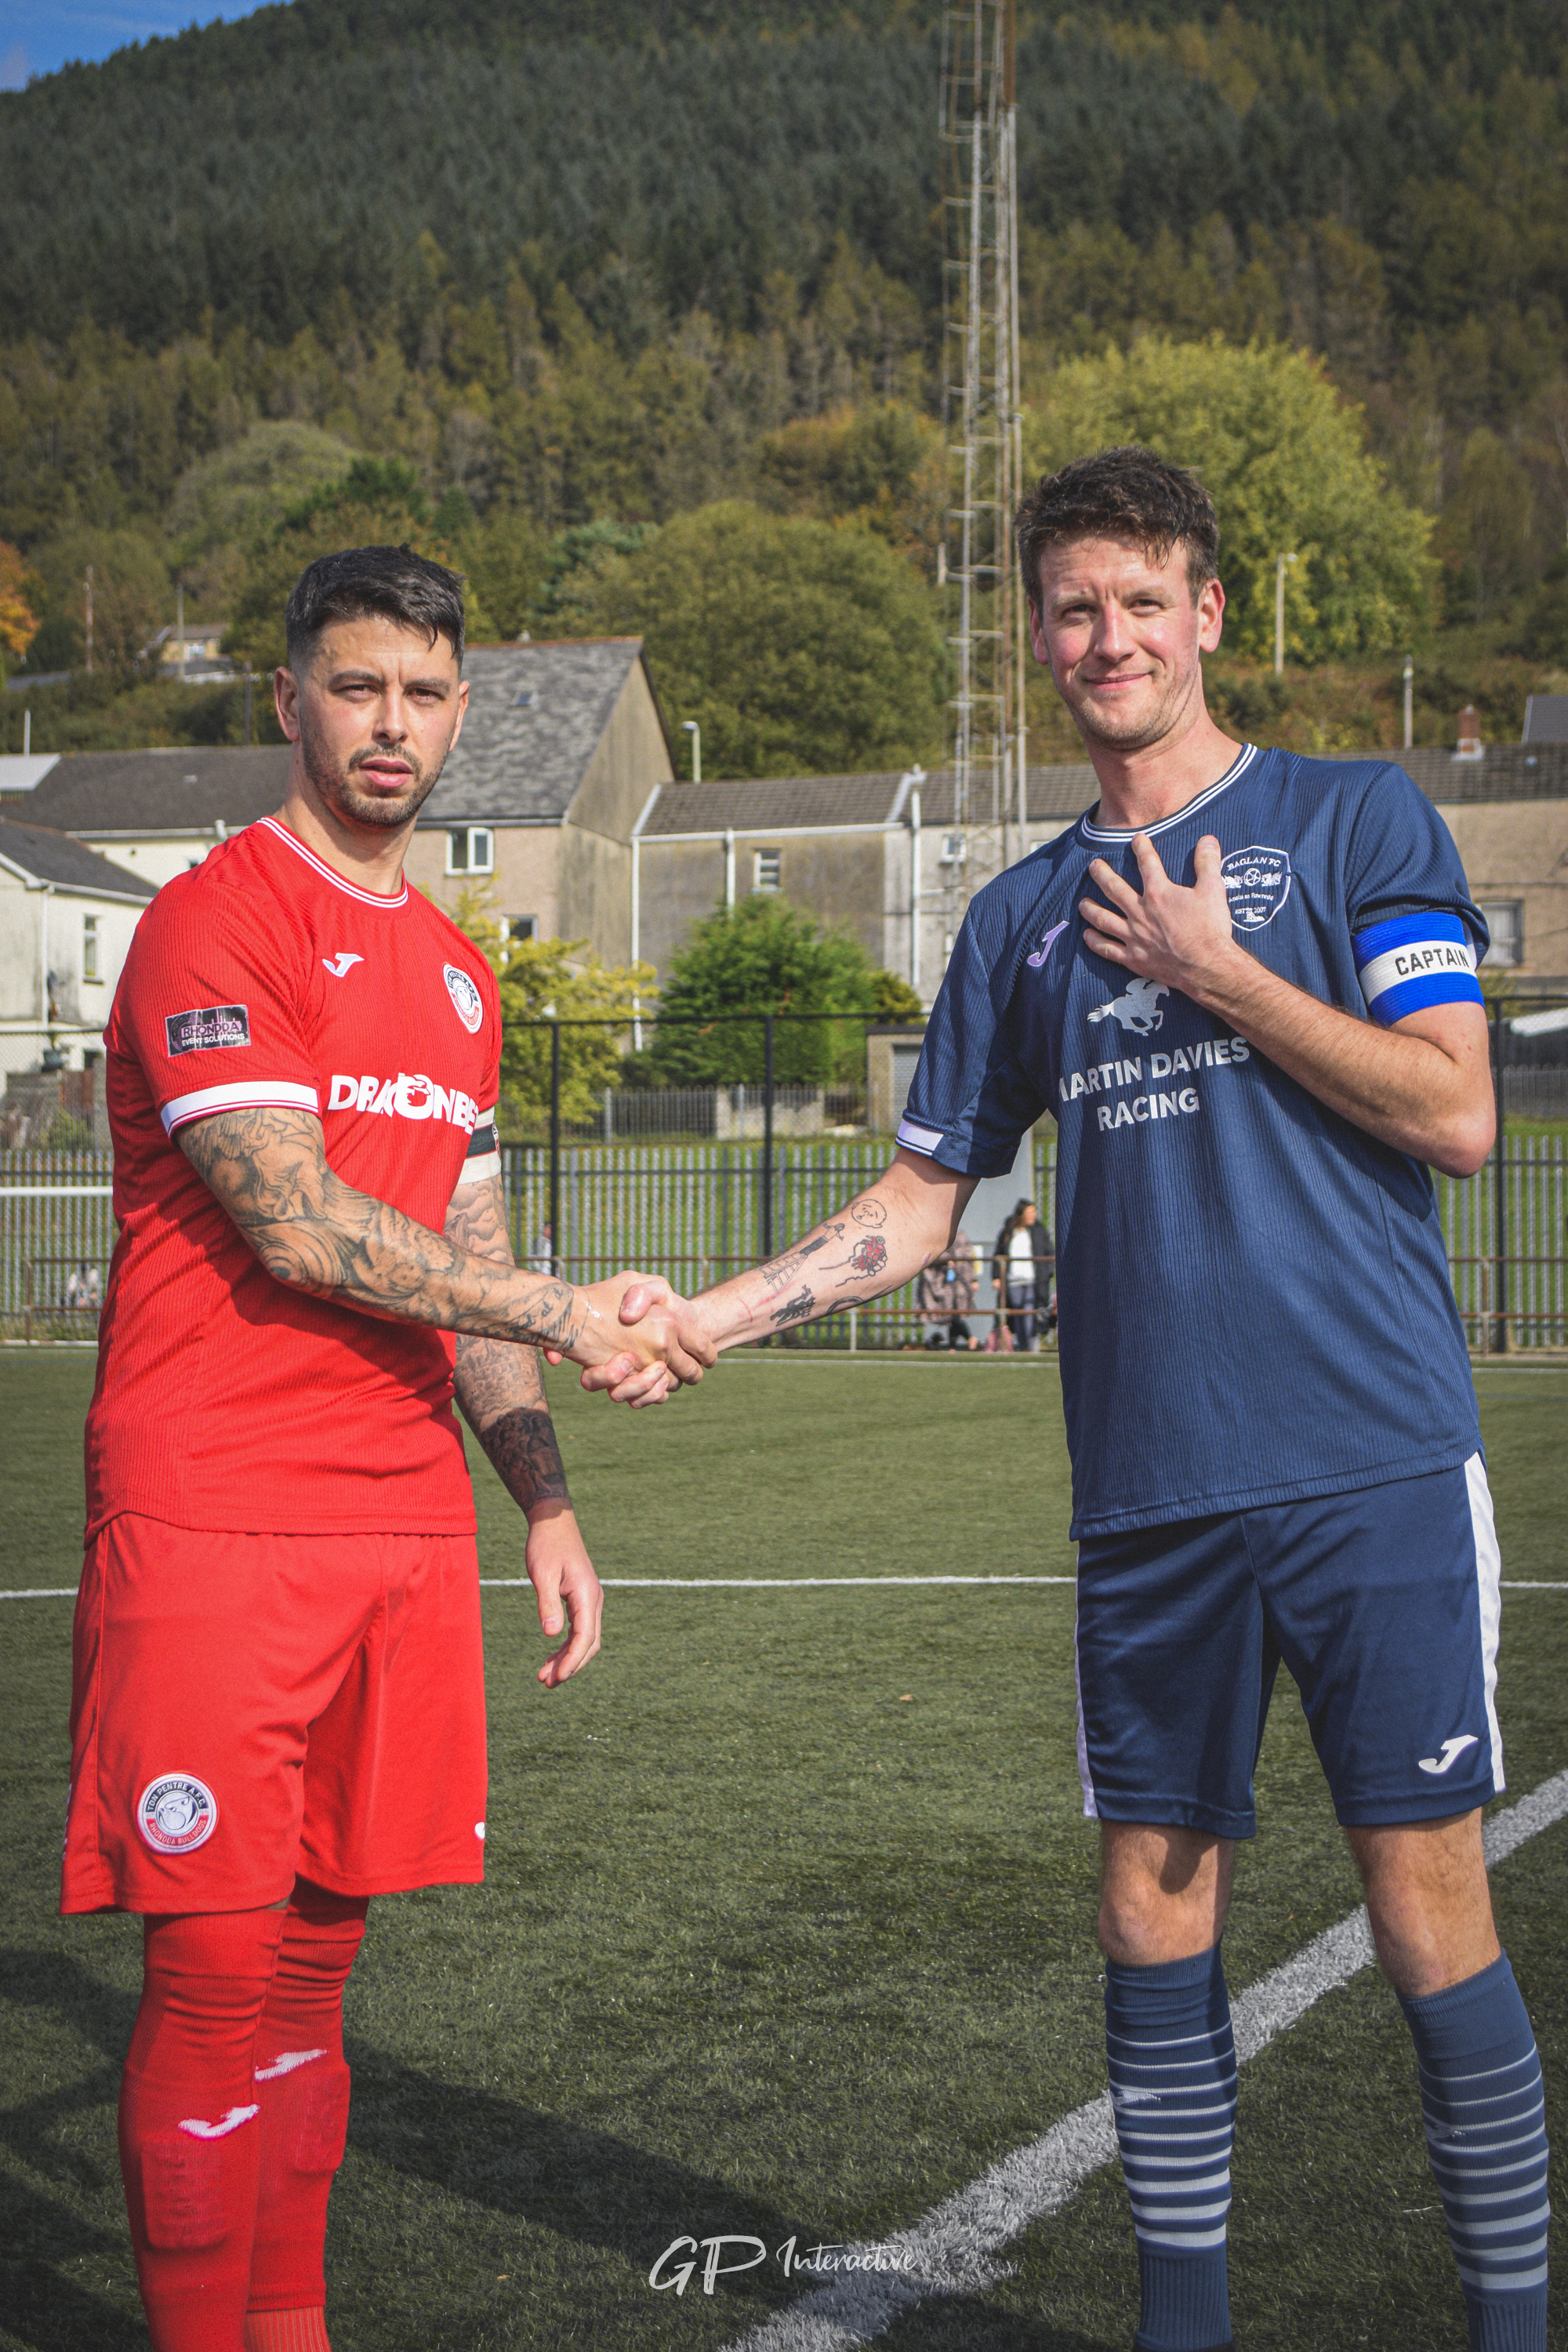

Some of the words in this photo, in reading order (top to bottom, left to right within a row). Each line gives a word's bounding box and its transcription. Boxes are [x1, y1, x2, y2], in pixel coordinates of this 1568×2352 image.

[1227, 856, 1268, 871] BAGLAN
[1269, 858, 1282, 867] FC
[1395, 947, 1470, 976] CAPTAIN
[181, 1036, 203, 1047] EVENT
[204, 1033, 245, 1044] SOLUTIONS
[183, 1022, 240, 1036] RHONDDA
[1150, 1036, 1250, 1079] DAVIES
[328, 1072, 479, 1136] DRAGONBE
[1097, 1087, 1200, 1131] RACING
[147, 1794, 159, 1812] TON
[157, 1781, 188, 1795] PENTRE
[149, 1822, 176, 1846] RHONDDA
[177, 1819, 207, 1846] BULLDOGS
